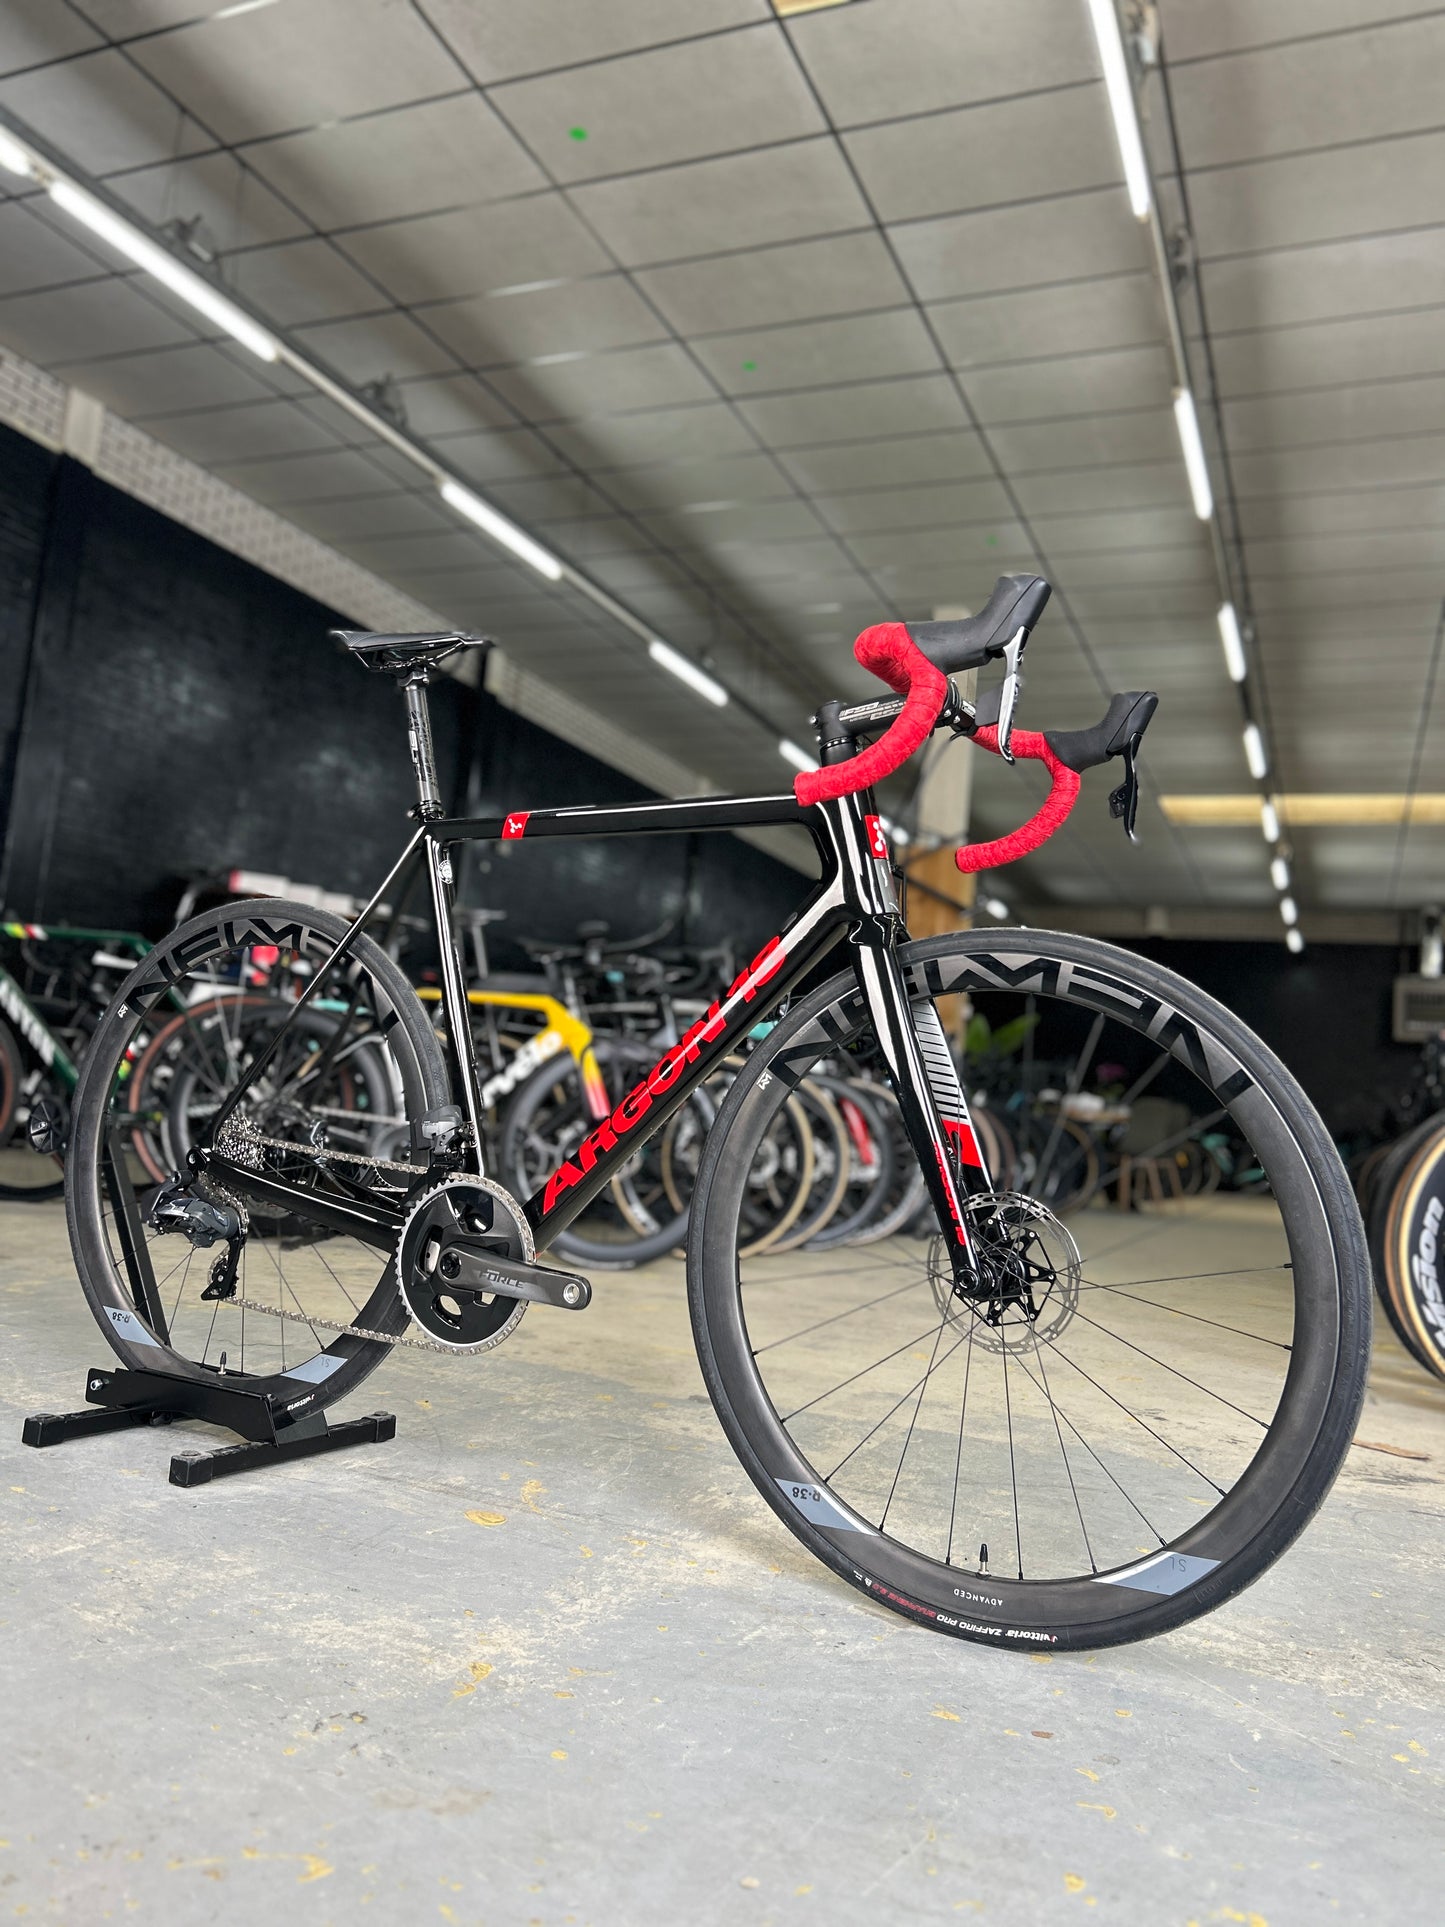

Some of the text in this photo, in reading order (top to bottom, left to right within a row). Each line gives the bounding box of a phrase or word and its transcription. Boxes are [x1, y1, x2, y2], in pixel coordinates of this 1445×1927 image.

[543, 1000, 727, 1214] ARGON
[727, 935, 786, 1003] 18
[479, 1271, 524, 1289] FORCE
[1169, 1556, 1187, 1572] SL
[953, 1588, 1004, 1607] ADVANCED
[936, 1613, 958, 1626] PRO
[959, 1621, 1003, 1636] ZAFFIRO
[1006, 1629, 1053, 1643] vittoria
